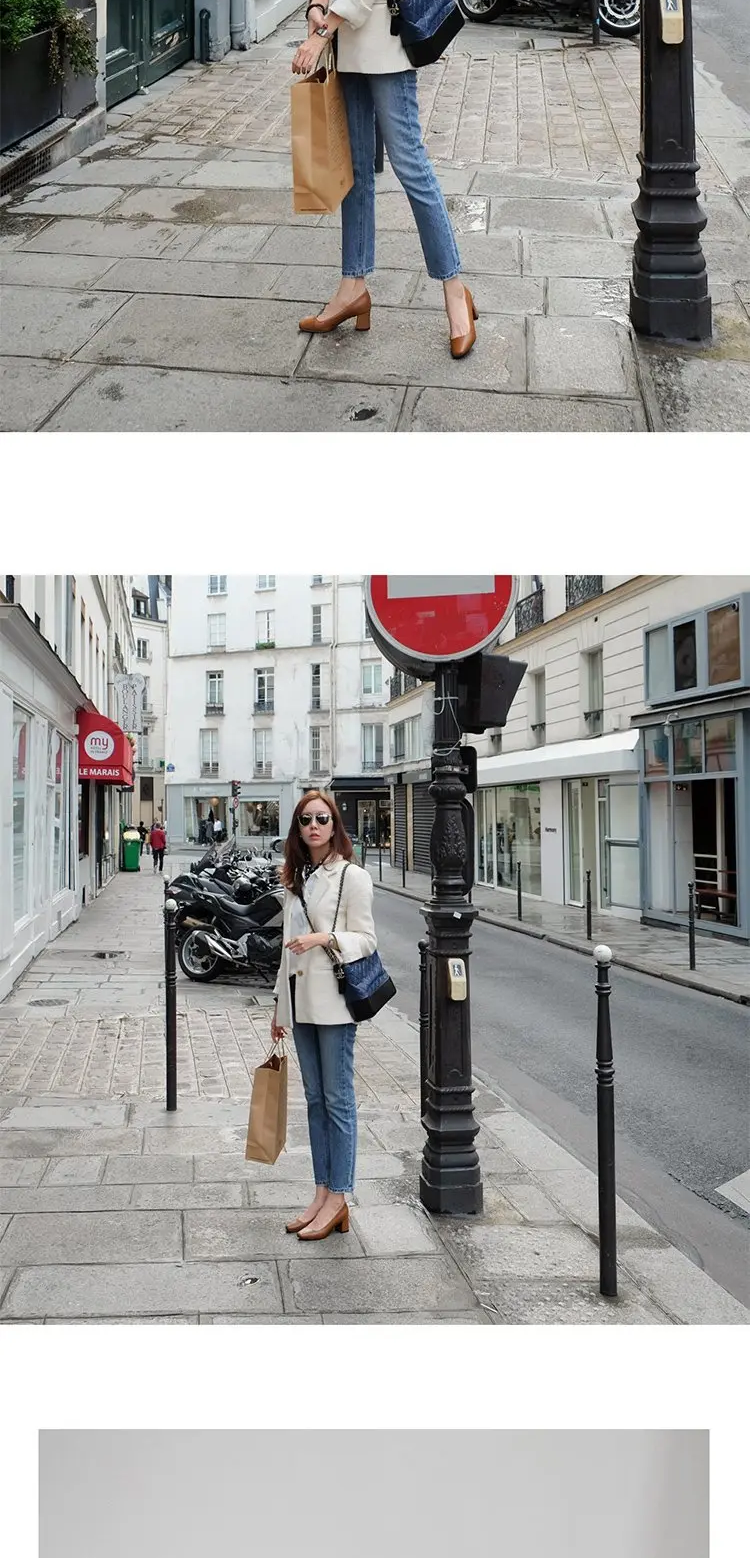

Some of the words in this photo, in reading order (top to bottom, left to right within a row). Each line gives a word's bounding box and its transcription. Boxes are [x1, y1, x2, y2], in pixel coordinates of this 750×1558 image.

[90, 737, 109, 750] my
[78, 768, 88, 776] LE
[89, 768, 120, 776] MARAIS
